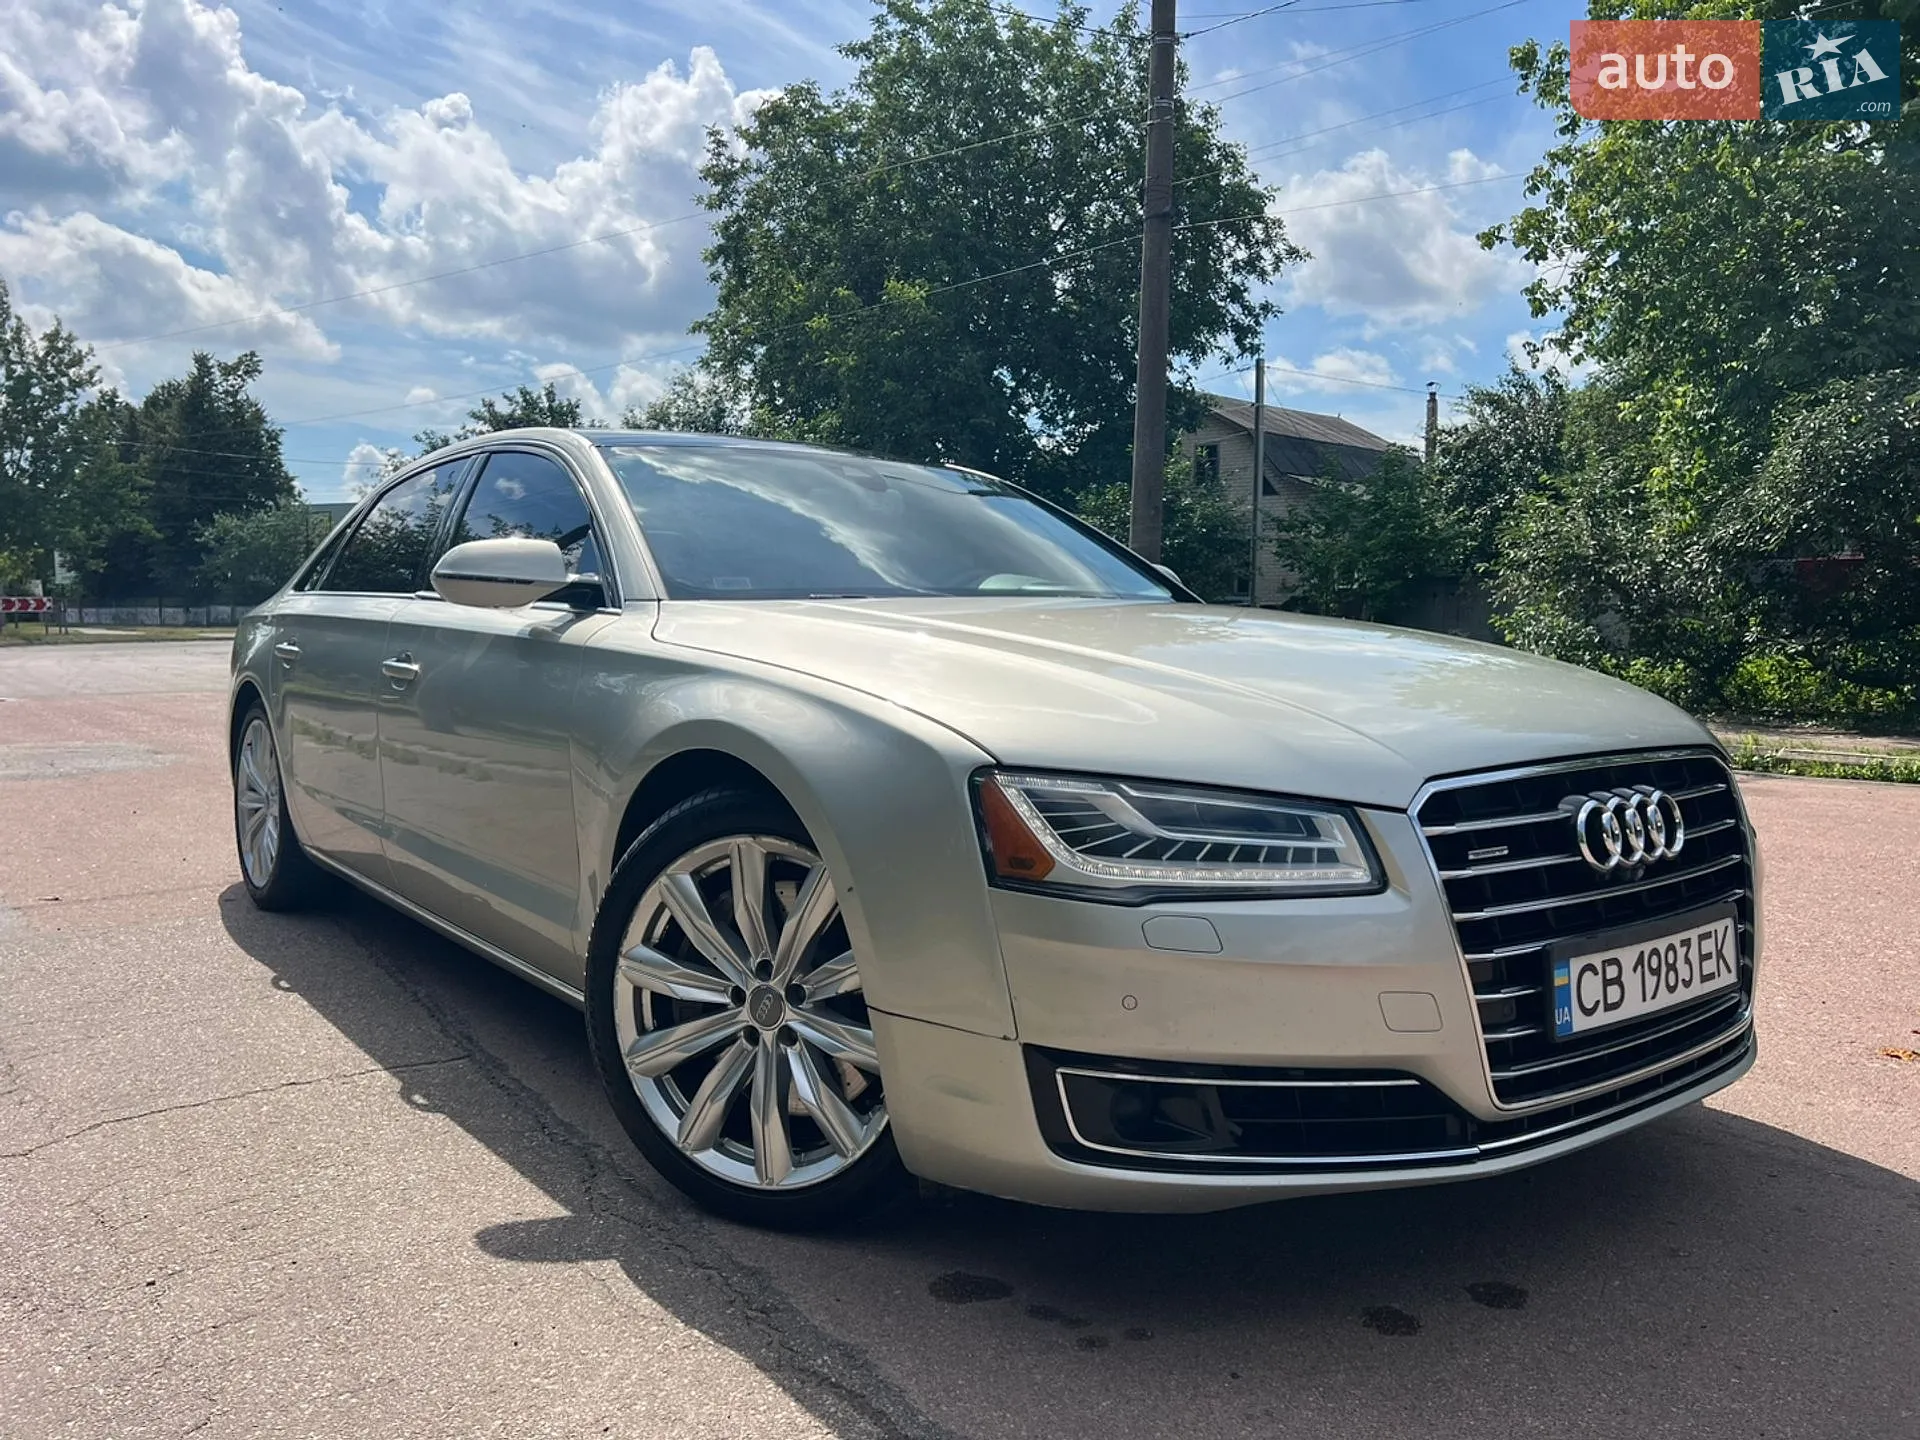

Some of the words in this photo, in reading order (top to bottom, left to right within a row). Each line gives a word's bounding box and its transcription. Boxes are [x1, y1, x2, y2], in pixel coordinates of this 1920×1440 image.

[1576, 957, 1625, 1017] CB
[1632, 937, 1693, 1002] 1983
[1697, 925, 1732, 984] EK
[1555, 1006, 1571, 1025] UA
